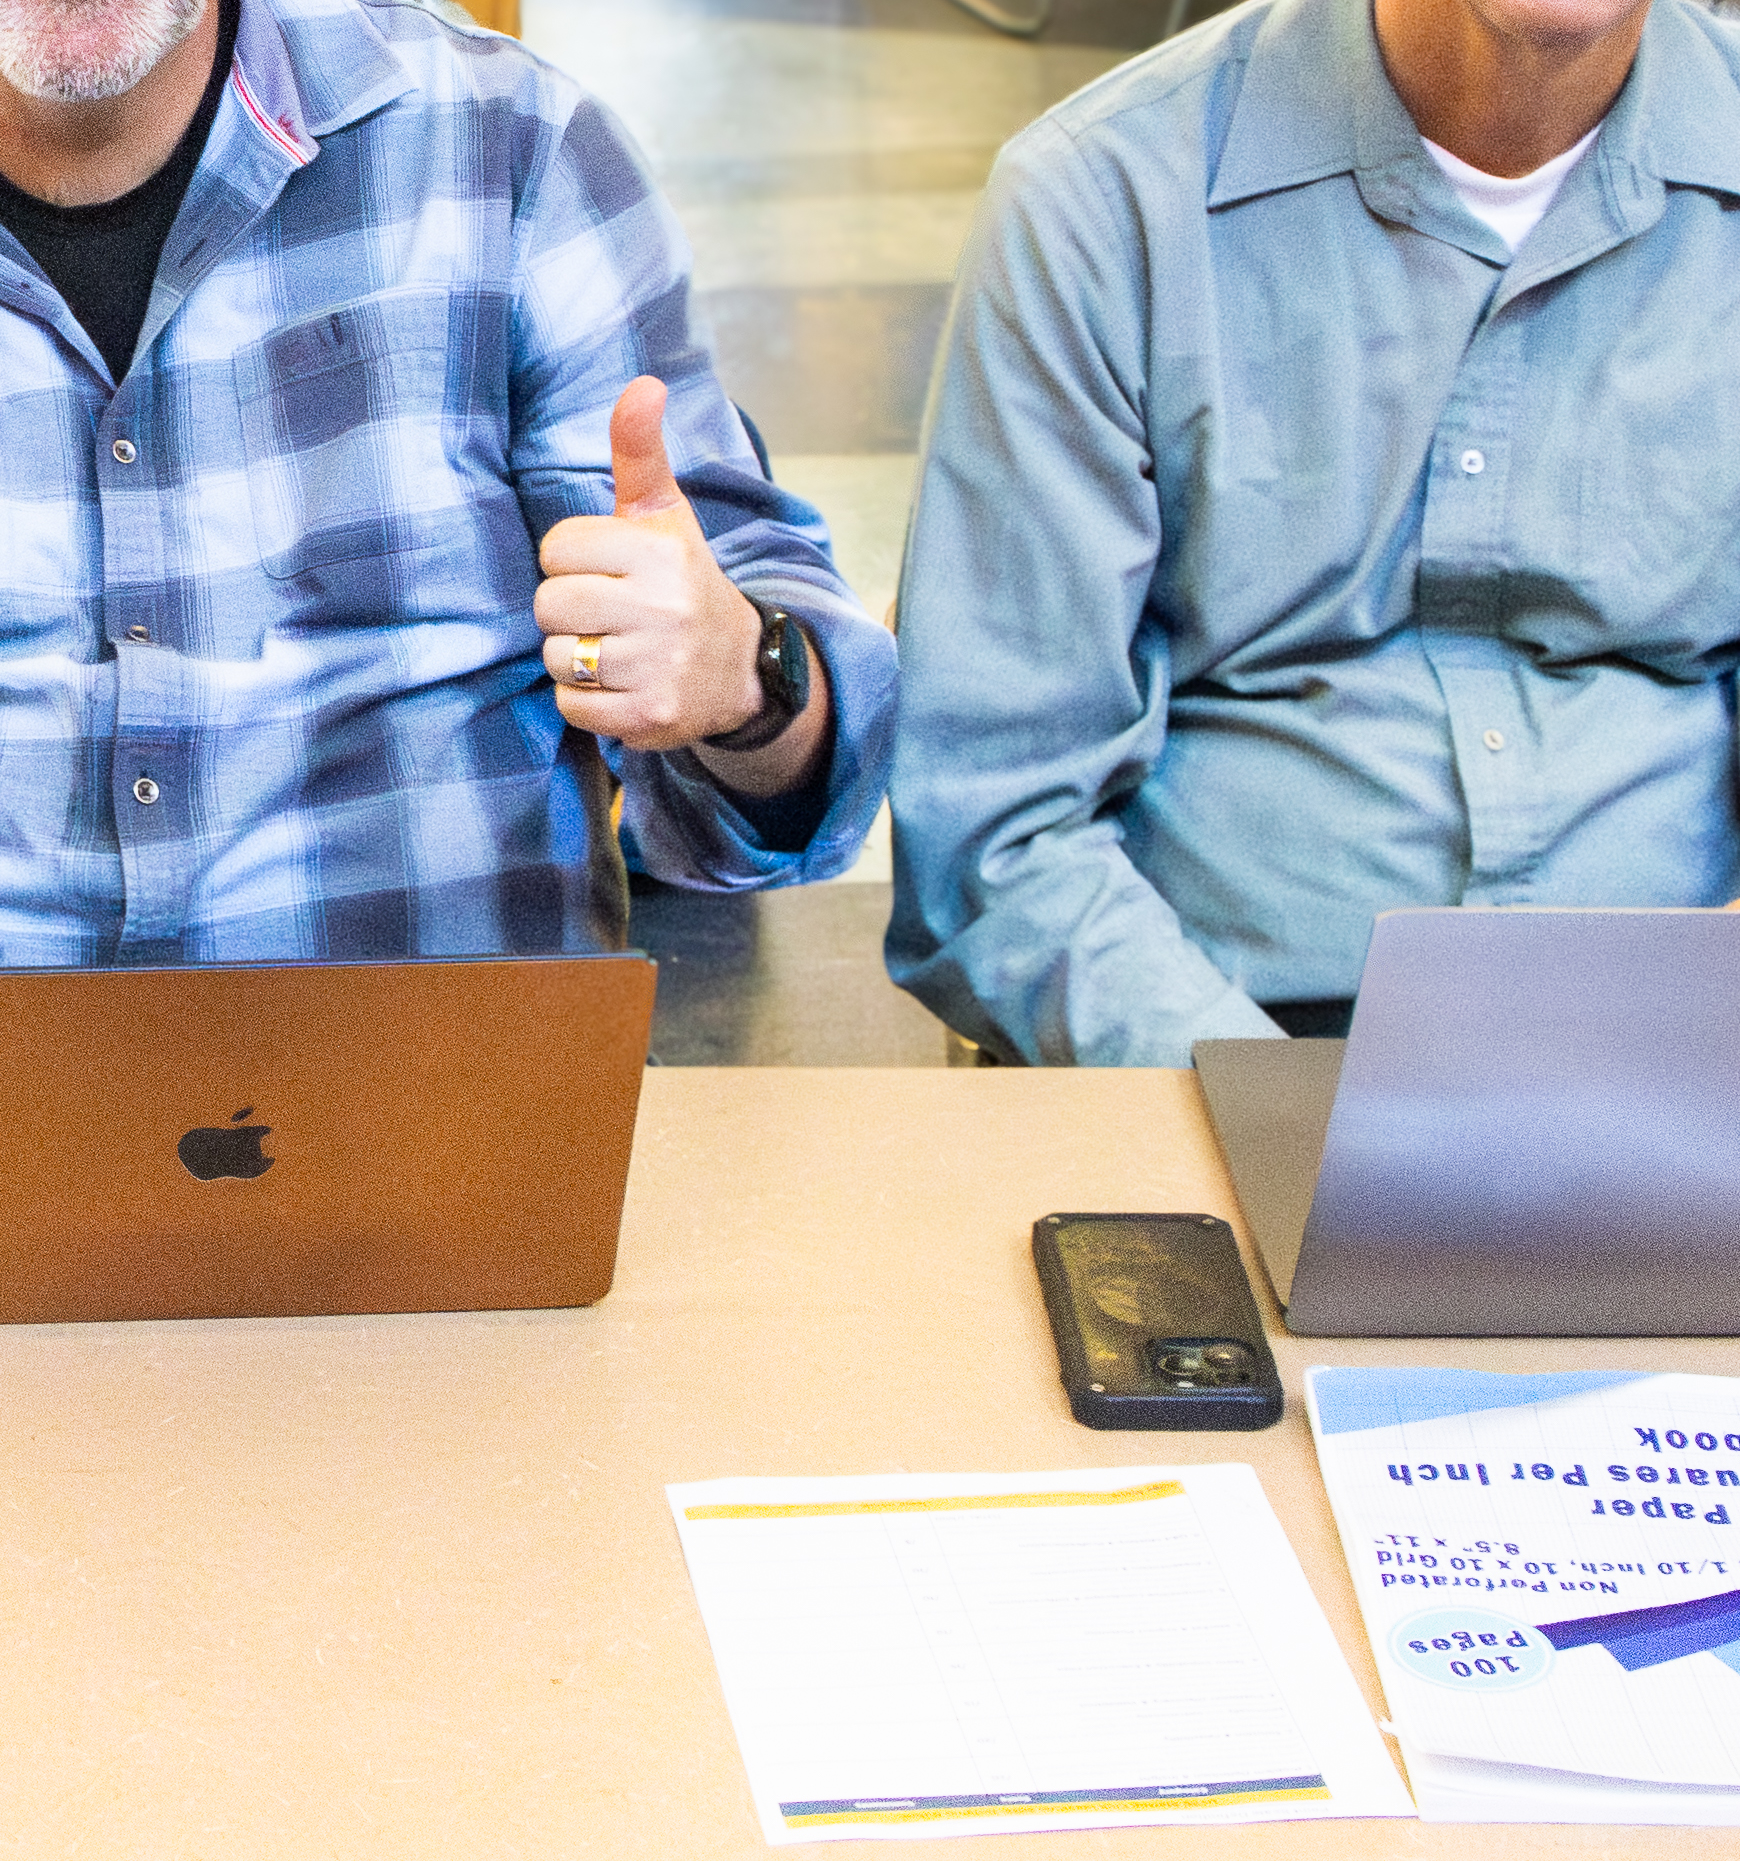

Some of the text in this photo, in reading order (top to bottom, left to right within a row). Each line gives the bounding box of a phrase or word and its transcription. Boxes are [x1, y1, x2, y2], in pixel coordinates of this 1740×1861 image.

[1387, 1462, 1491, 1487] Inch
[1511, 1462, 1589, 1488] Per
[1592, 1496, 1732, 1525] Paper
[1376, 1550, 1439, 1570] Grid
[1450, 1556, 1485, 1572] 10
[1524, 1561, 1559, 1576] 10
[1569, 1559, 1646, 1576] Inch,
[1657, 1558, 1727, 1576] 1/10
[1381, 1572, 1619, 1594] Non Perforated
[1408, 1629, 1529, 1654] Pages
[1450, 1655, 1520, 1678] 100
